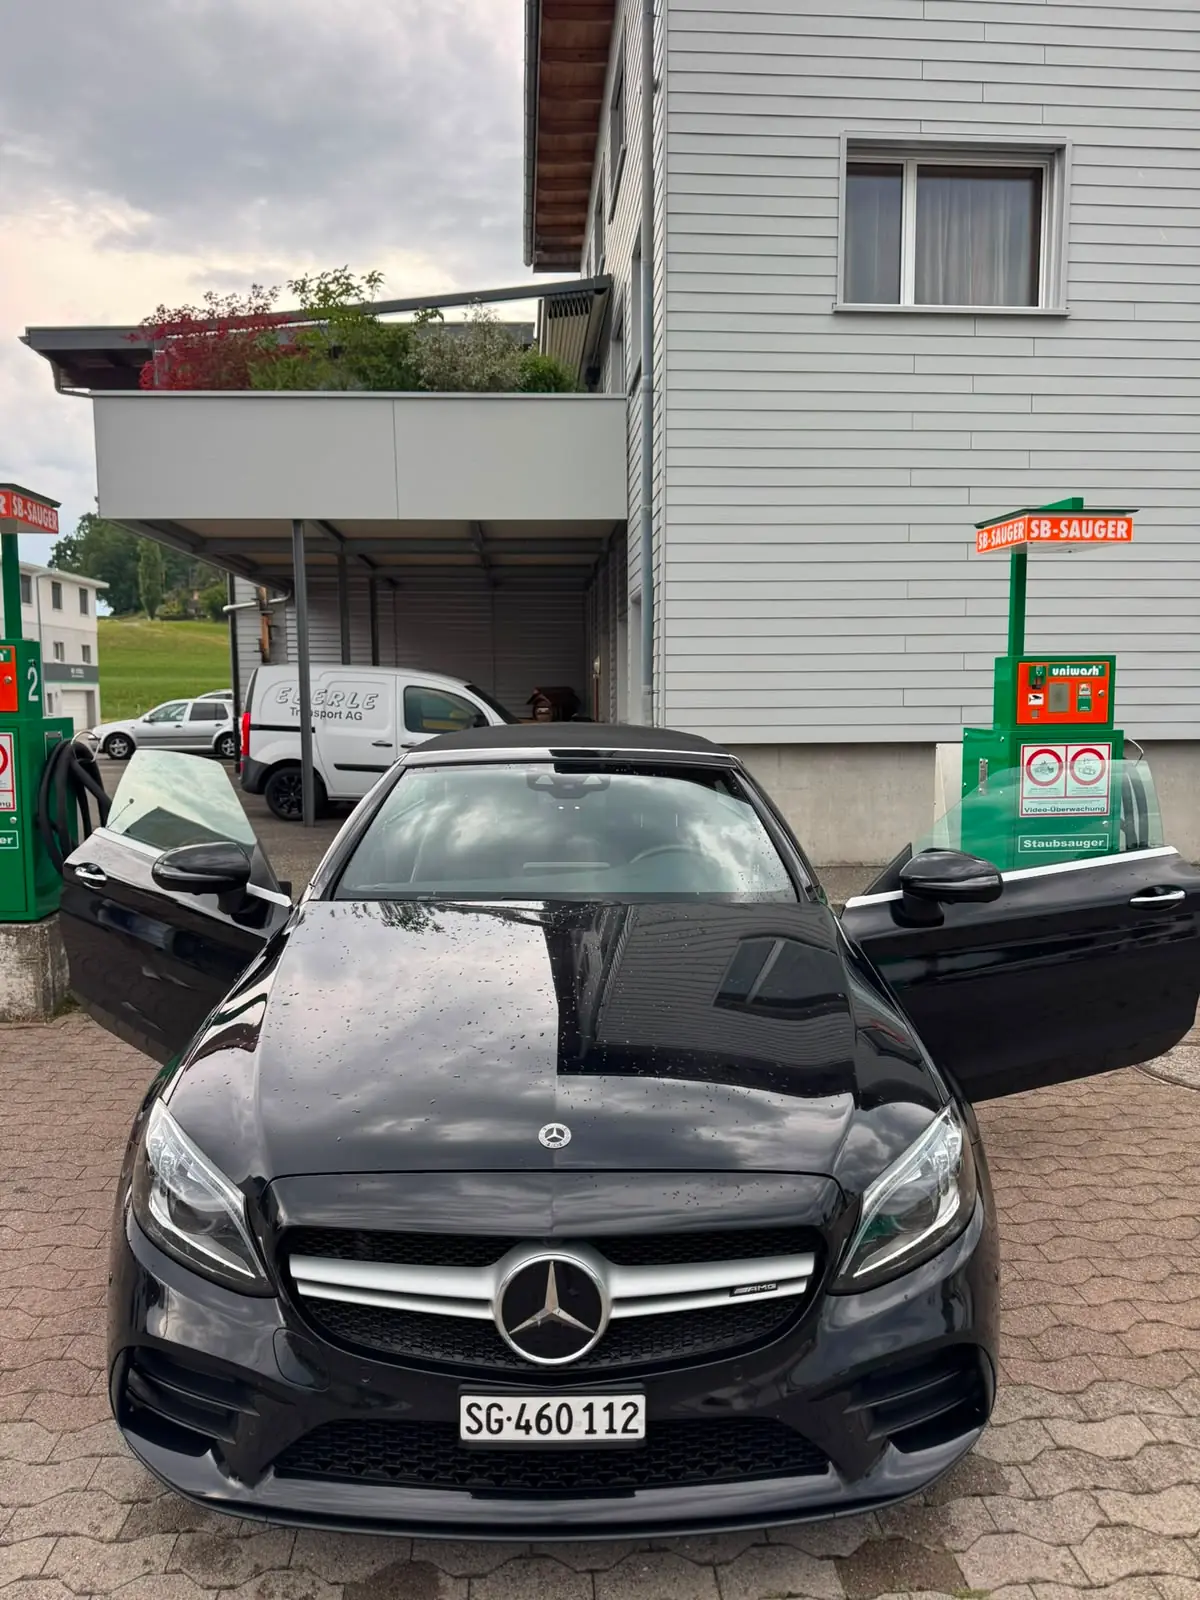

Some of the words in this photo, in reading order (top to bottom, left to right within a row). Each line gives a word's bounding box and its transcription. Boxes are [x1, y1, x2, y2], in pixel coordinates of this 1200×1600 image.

[12, 495, 58, 531] SB-SAUGER
[978, 522, 1025, 549] SB-SAUGER
[1029, 519, 1129, 539] SB-SAUGER
[27, 666, 39, 701] 2
[290, 706, 342, 719] Trsport
[345, 711, 363, 721] AG
[1024, 805, 1106, 814] Video-Überwachung
[1023, 839, 1105, 849] Staubsauger
